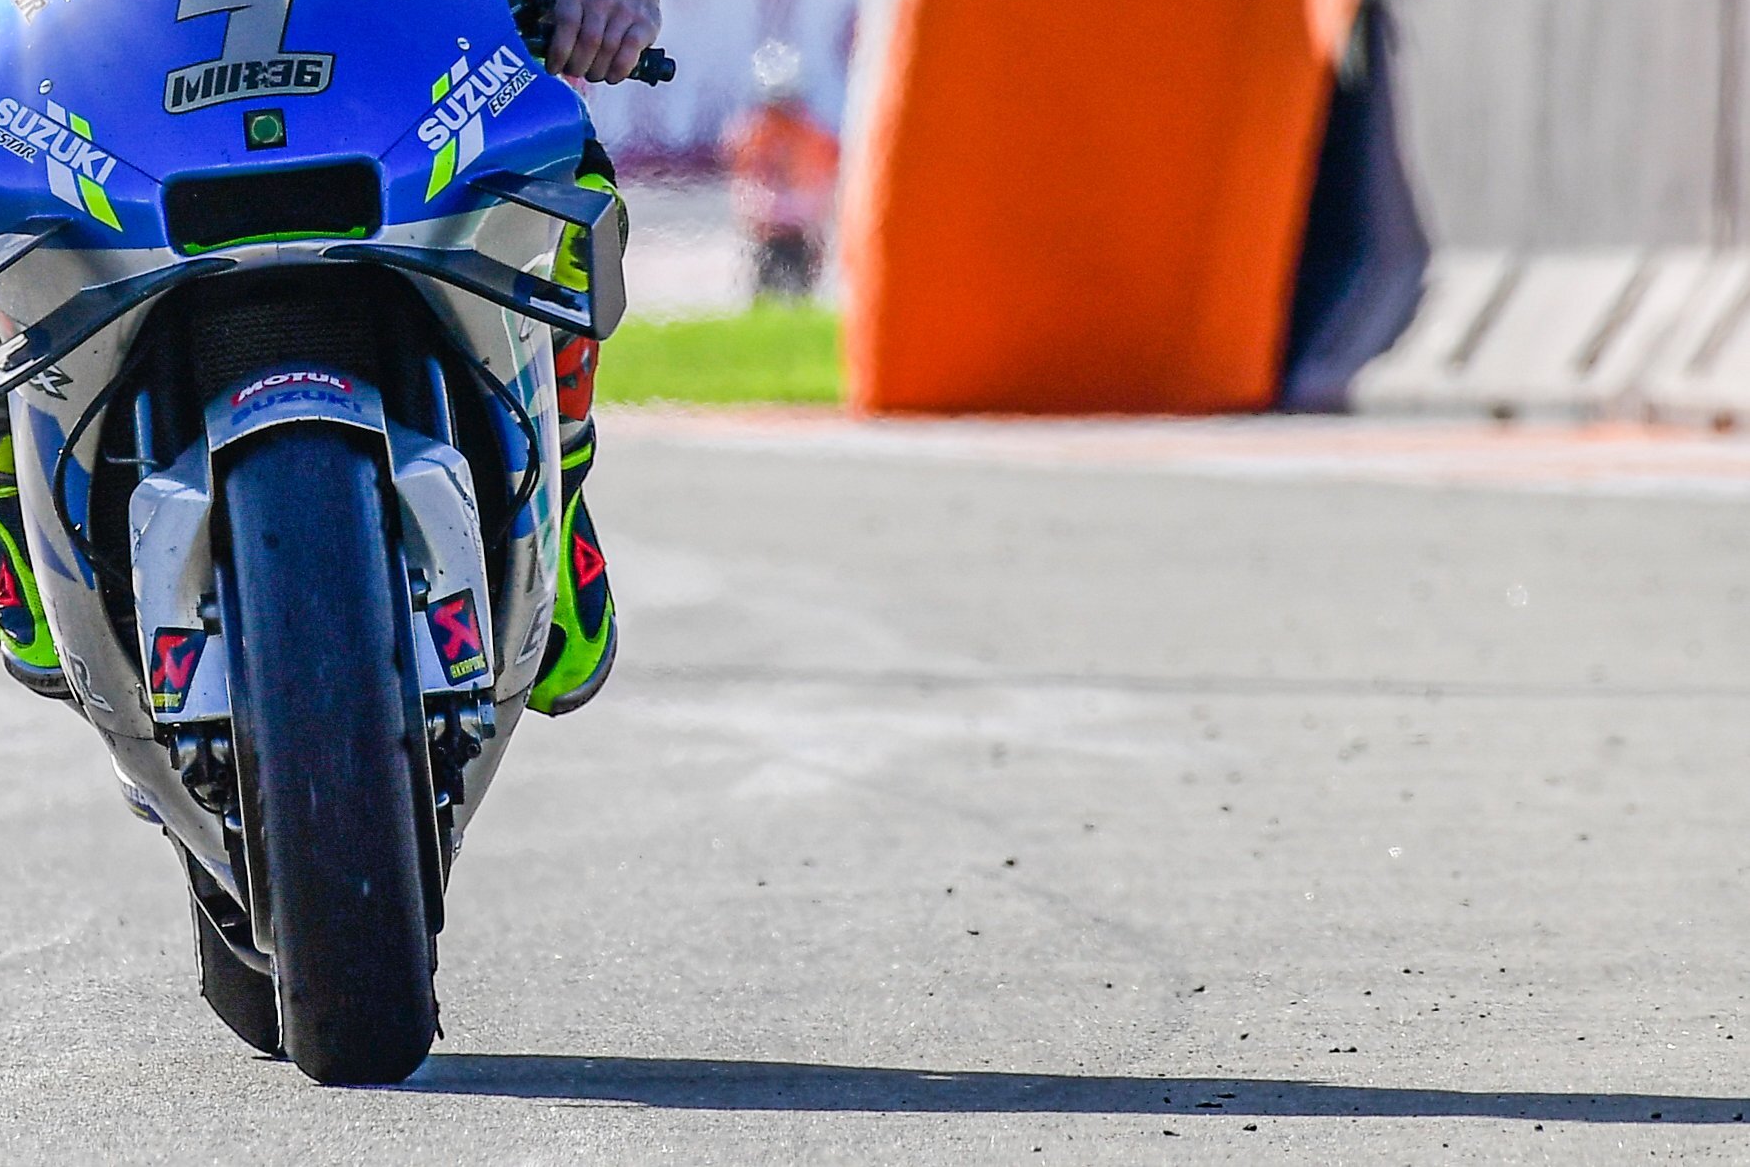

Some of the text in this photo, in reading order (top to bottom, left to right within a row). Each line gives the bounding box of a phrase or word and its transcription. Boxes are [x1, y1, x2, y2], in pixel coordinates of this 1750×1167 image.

[417, 45, 525, 151] SUZUKI
[489, 70, 533, 115] ECSTAR
[238, 372, 346, 402] MOTUL
